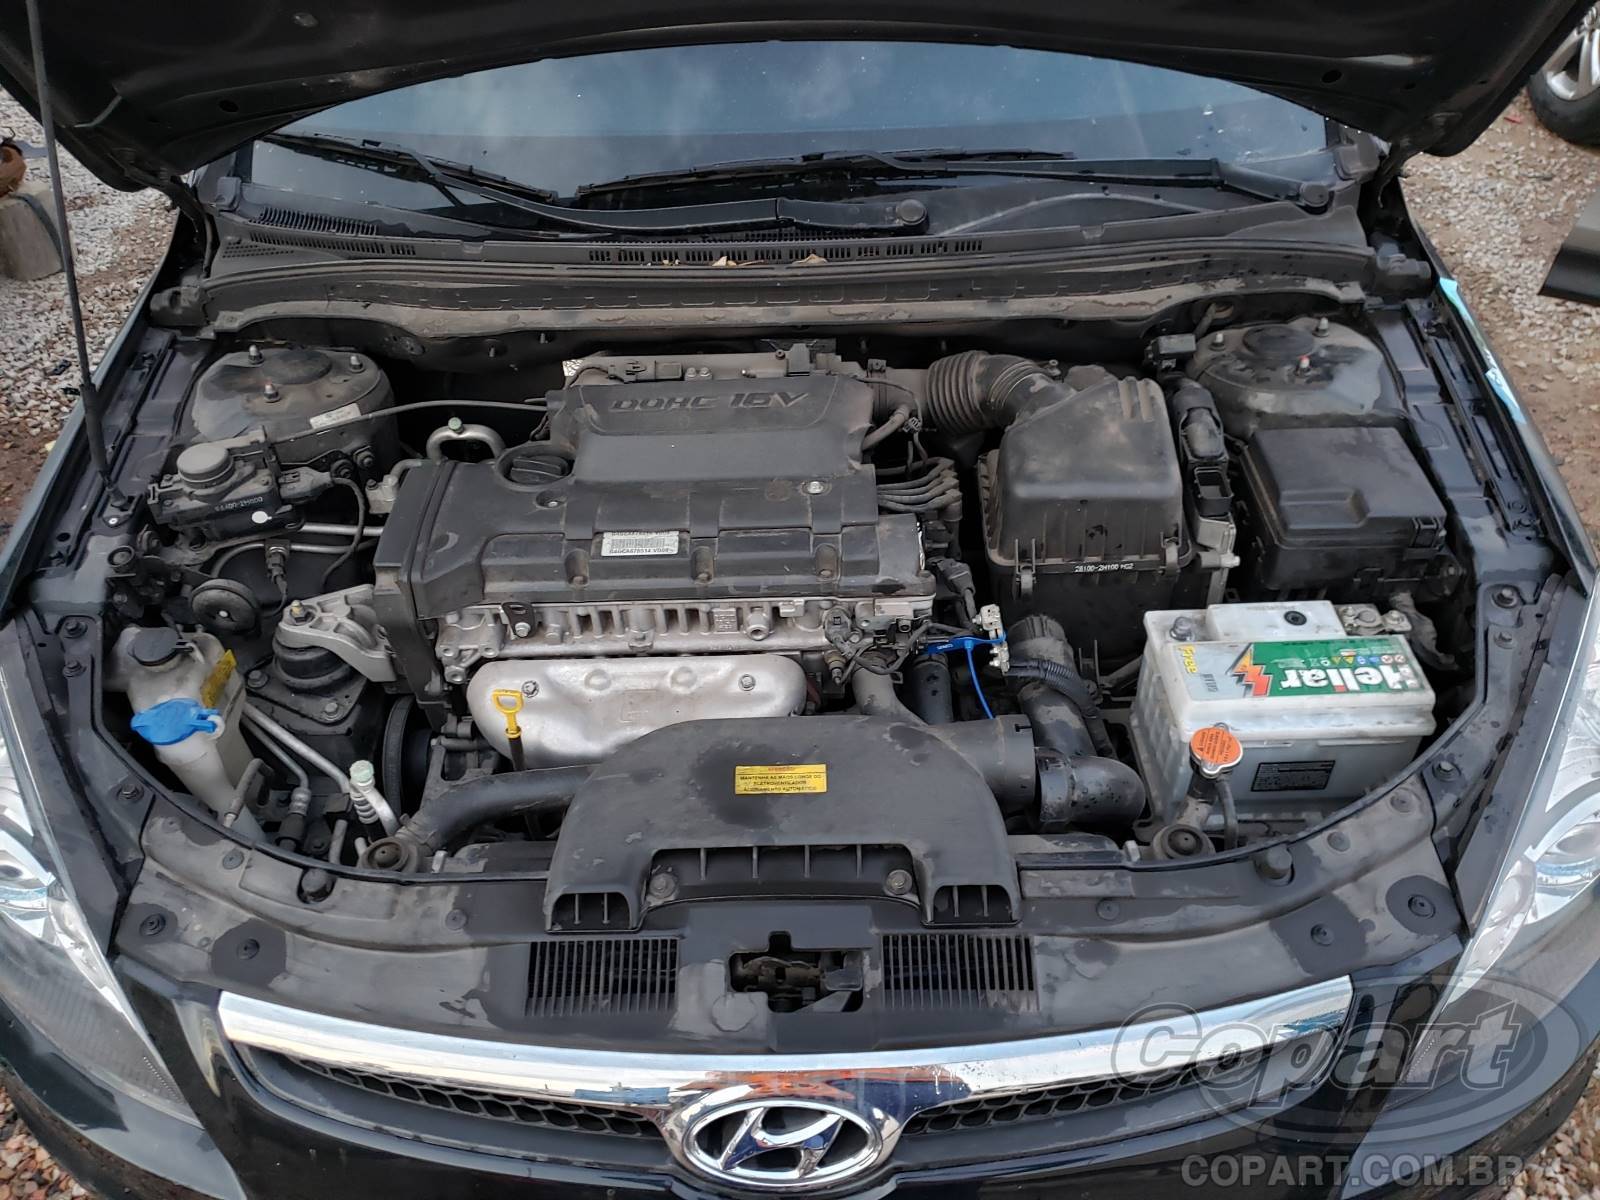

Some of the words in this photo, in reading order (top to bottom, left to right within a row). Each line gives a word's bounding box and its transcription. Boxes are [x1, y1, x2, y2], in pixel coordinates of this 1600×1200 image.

[611, 395, 718, 410] DOHC
[729, 392, 808, 408] 16V
[1280, 664, 1419, 694] Heliar
